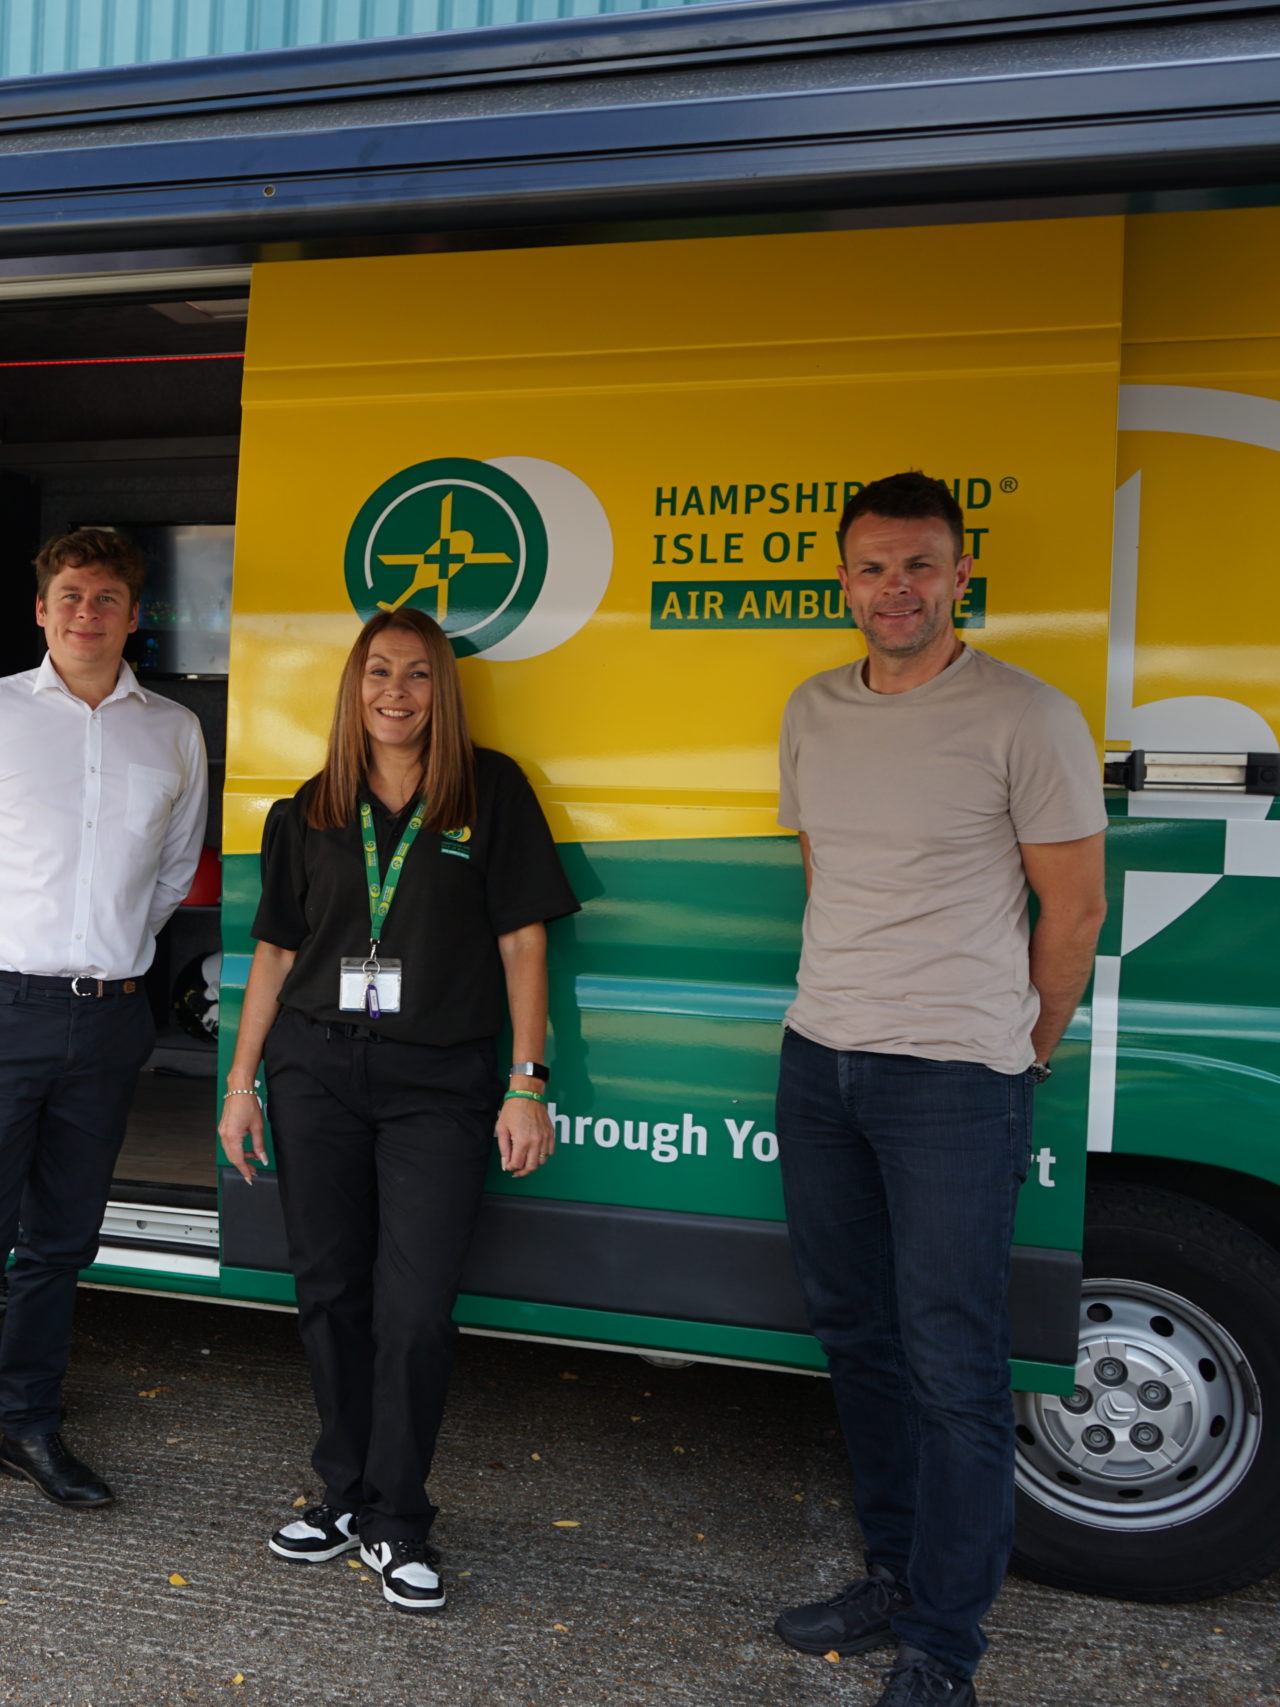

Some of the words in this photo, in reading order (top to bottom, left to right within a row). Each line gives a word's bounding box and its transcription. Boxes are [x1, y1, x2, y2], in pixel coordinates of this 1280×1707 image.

[655, 481, 865, 516] HAMPSHIR
[652, 532, 744, 565] ISLE
[762, 530, 818, 562] OF
[660, 591, 725, 621] AIR
[547, 1102, 708, 1163] hrough
[723, 1118, 779, 1163] Yo
